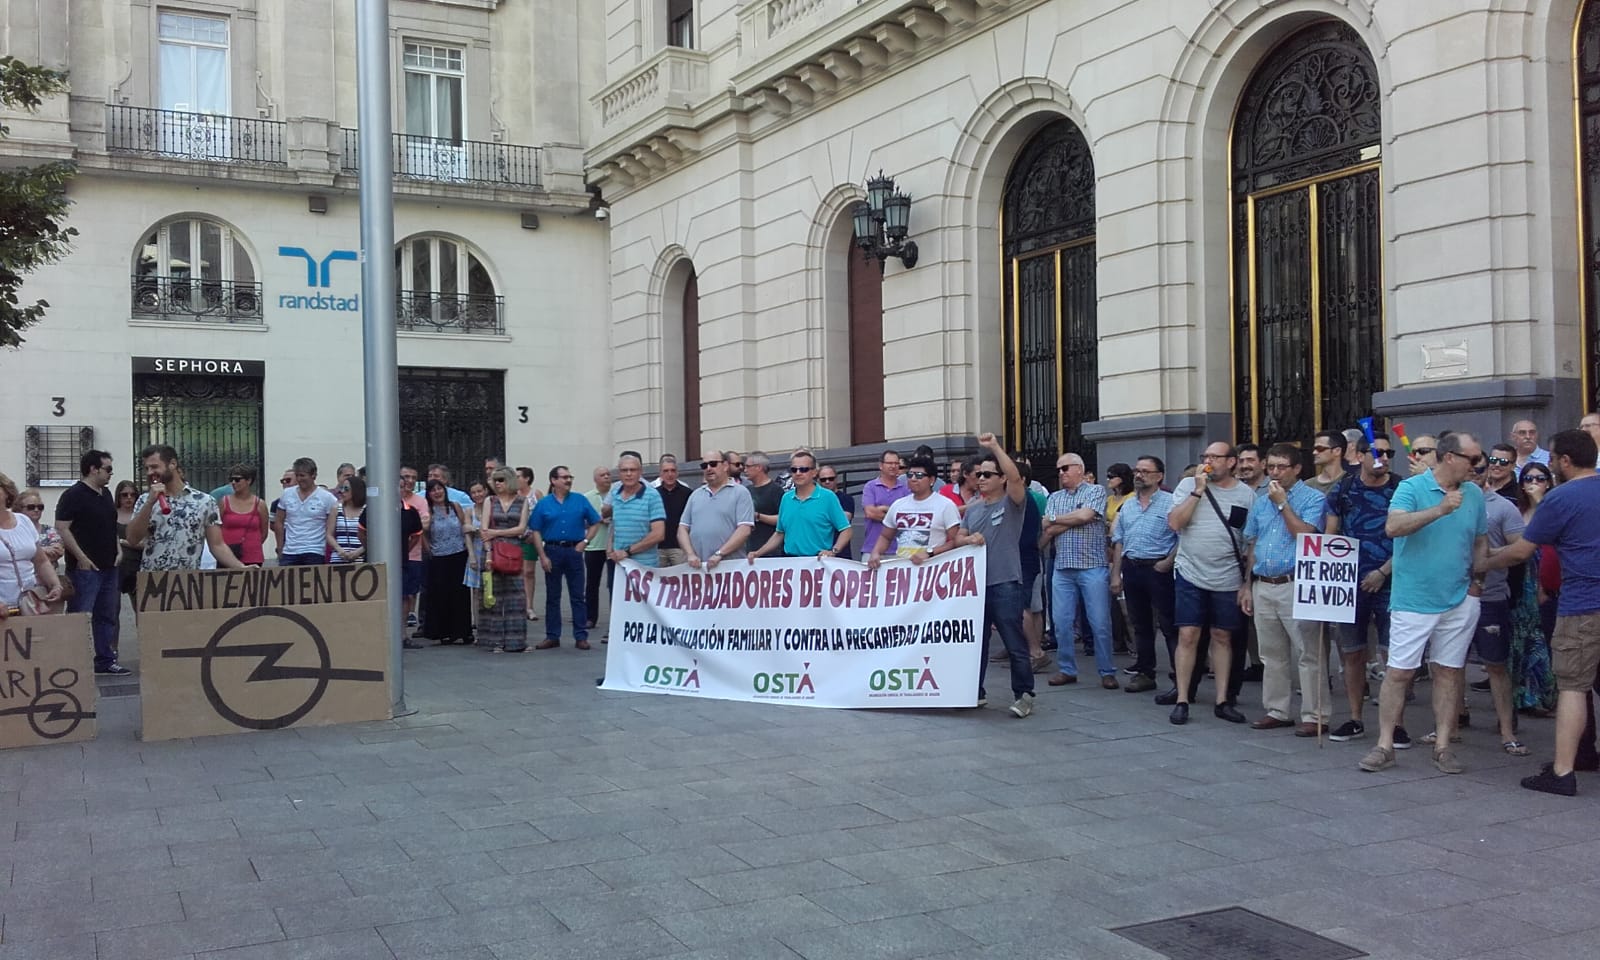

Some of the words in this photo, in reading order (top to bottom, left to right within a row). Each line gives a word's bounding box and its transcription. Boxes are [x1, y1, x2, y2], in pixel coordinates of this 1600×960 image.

[279, 291, 358, 312] randstad
[155, 359, 243, 374] SEPHORA
[52, 397, 65, 417] 3
[518, 406, 528, 423] 3
[656, 568, 793, 610] TRABAJADORES
[800, 567, 825, 608] DE
[830, 569, 879, 608] OPEL
[885, 567, 912, 607] EN
[913, 556, 978, 602] LUCHA
[1298, 560, 1316, 580] ME
[1320, 561, 1357, 583] ROBEN
[140, 565, 378, 612] MANTENIMIENTO
[1298, 584, 1316, 604] LA
[1321, 585, 1354, 607] VIDA
[624, 621, 644, 643] POR
[646, 623, 657, 644] LA
[727, 628, 772, 650] FAMILIAR
[775, 628, 782, 650] Y
[784, 628, 828, 651] CONTRA
[831, 628, 843, 651] LA
[846, 624, 920, 650] PRECARIEDAD
[921, 619, 975, 644] LABORAL
